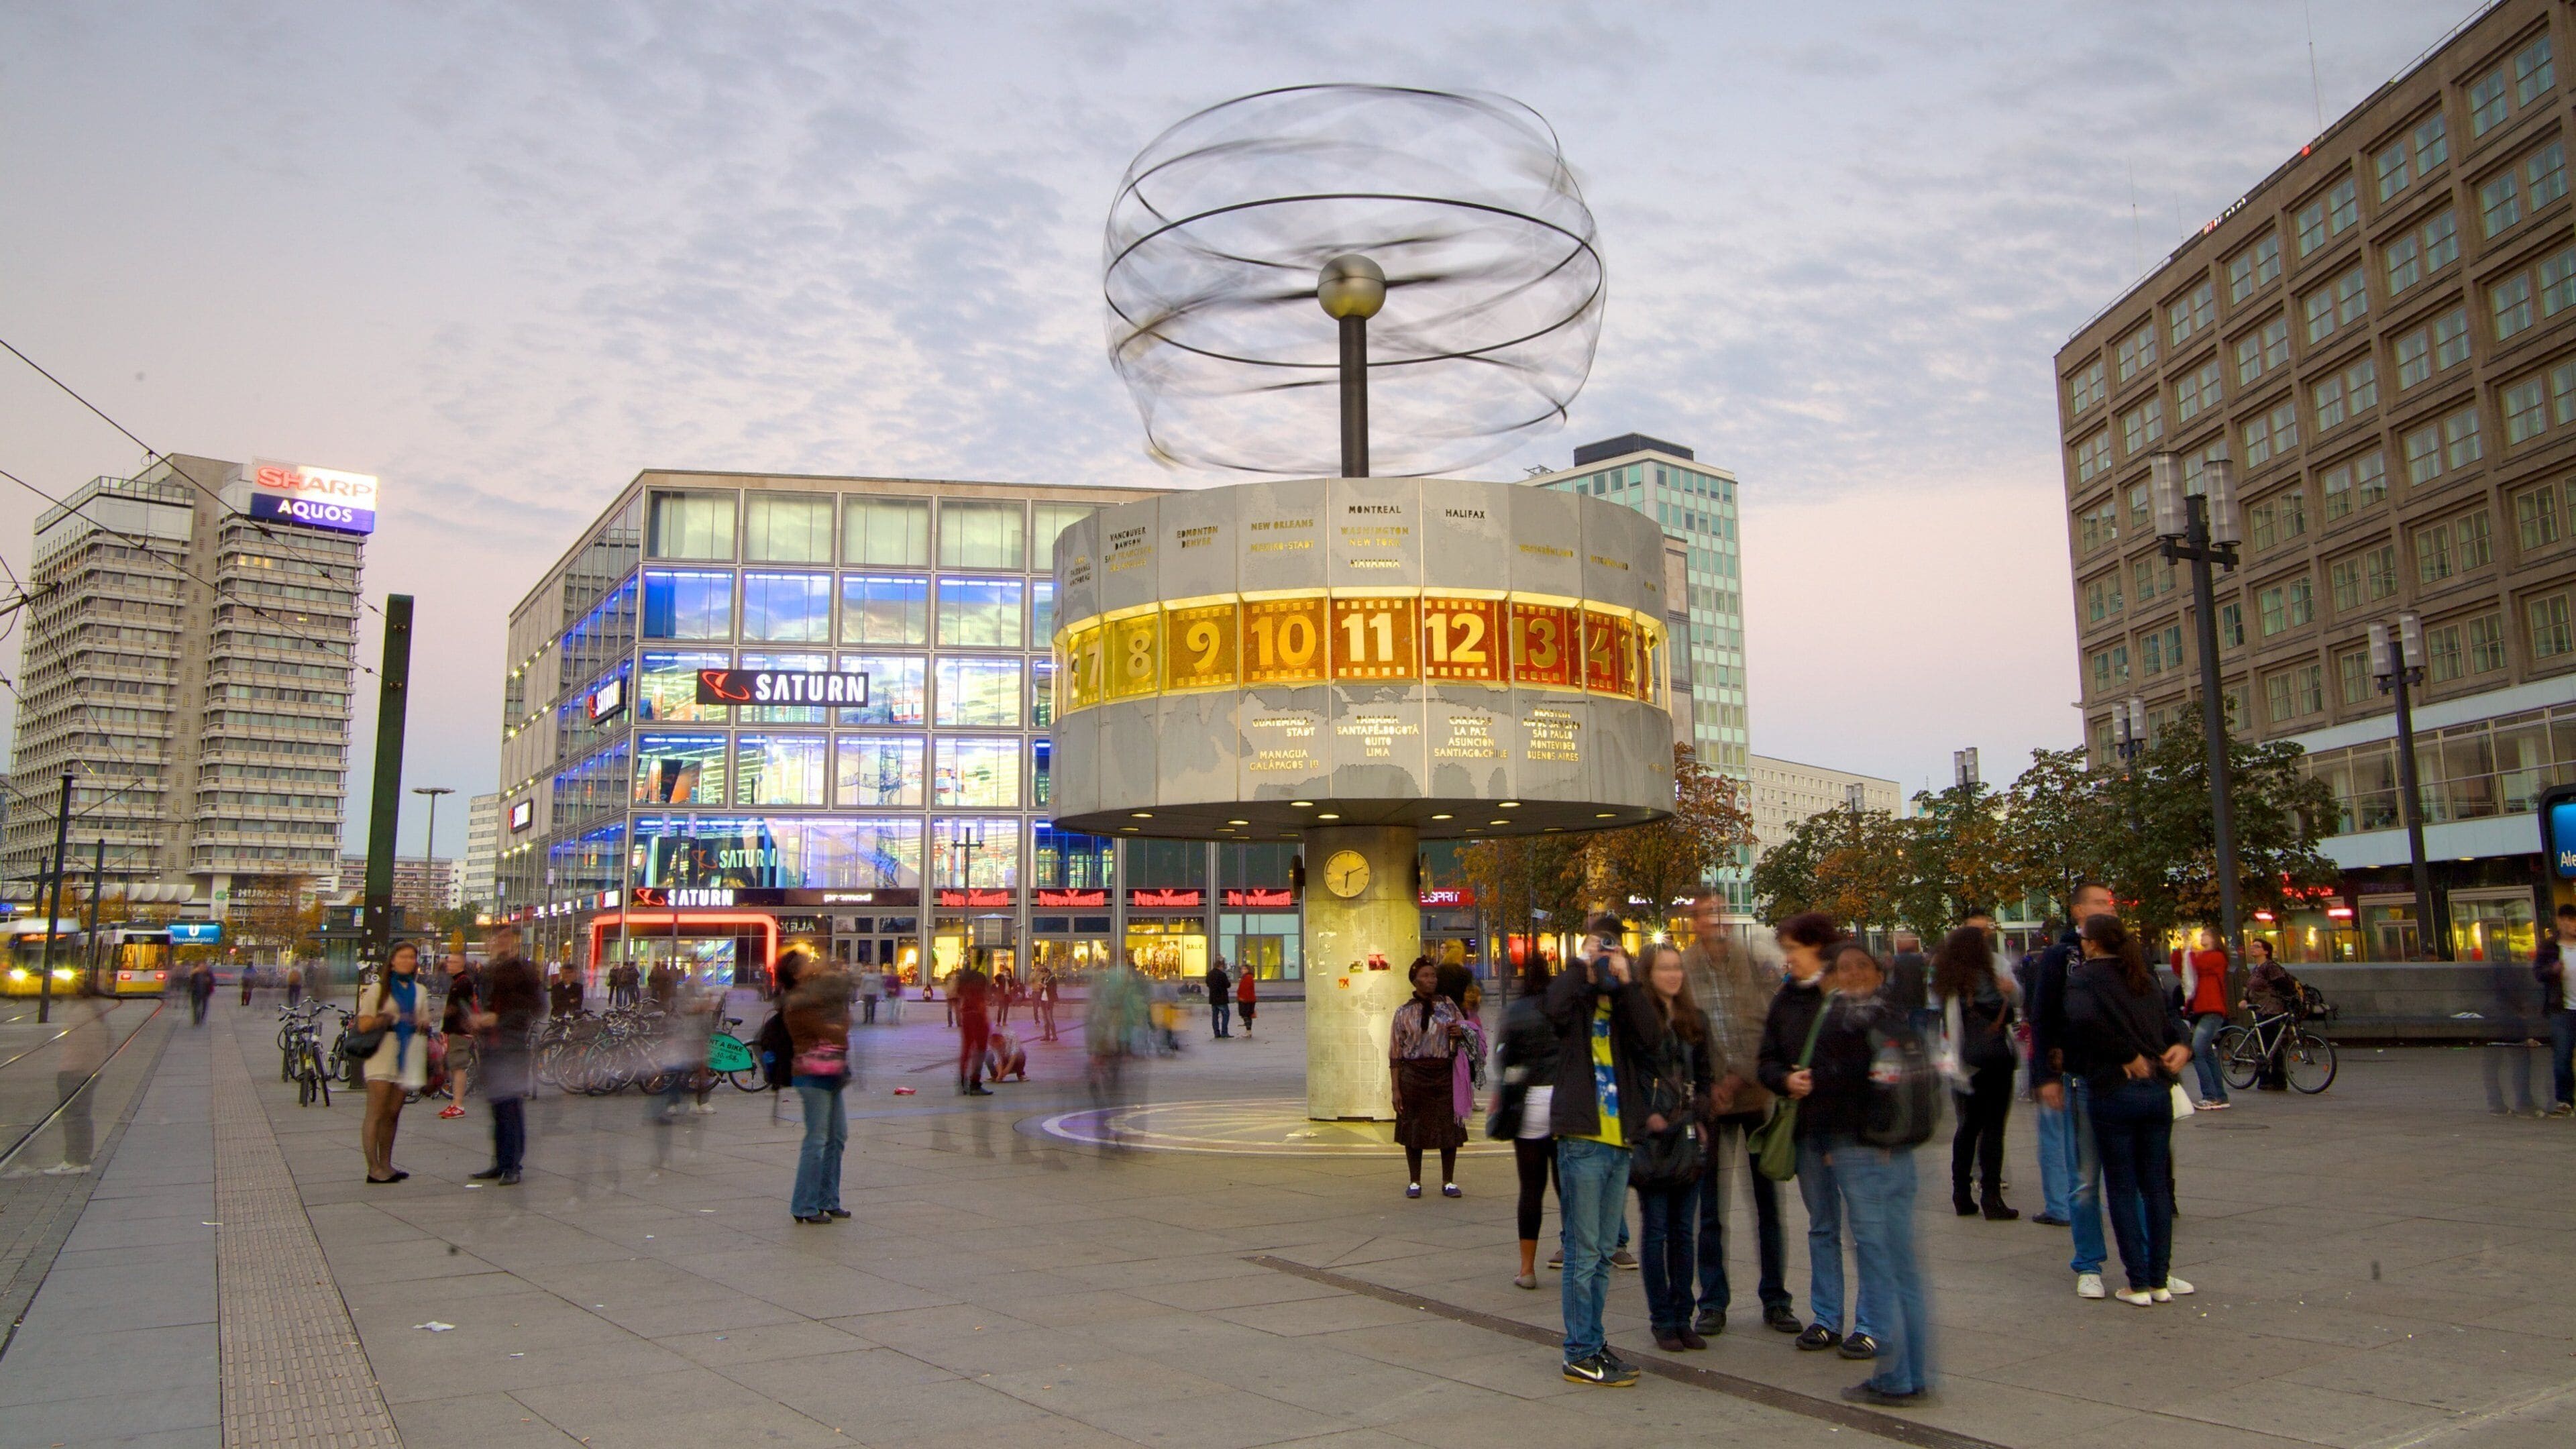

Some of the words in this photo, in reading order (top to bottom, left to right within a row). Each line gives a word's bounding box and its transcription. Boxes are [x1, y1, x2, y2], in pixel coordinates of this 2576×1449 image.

[258, 466, 372, 496] SHARP
[278, 500, 353, 523] AQUOS
[1348, 505, 1401, 514] MONTREAL
[1445, 508, 1485, 519] HALIFAX
[1250, 521, 1271, 531] NEW
[1274, 519, 1313, 529] ORLEANS
[1340, 527, 1409, 535] WASHINGTON
[1110, 526, 1146, 542] VANCOUVER
[1177, 525, 1218, 539] EDMONTON
[1114, 537, 1141, 551] DAWSON
[1181, 537, 1212, 548] DENVER
[1349, 538, 1371, 547] NEW
[1376, 538, 1401, 547] YORK
[1350, 559, 1401, 568] HAVANNA
[1251, 614, 1316, 665] 10
[1342, 612, 1393, 662] 11
[1426, 613, 1487, 663] 12
[1510, 617, 1558, 668] 13
[1186, 621, 1221, 669] 9
[1126, 631, 1152, 678] 8
[1086, 642, 1101, 688] 7
[755, 674, 865, 702] SATURN
[1449, 716, 1493, 726] CARACAS
[1286, 727, 1316, 737] STADT
[1454, 727, 1466, 736] LA
[1470, 727, 1488, 737] PAZ
[1532, 728, 1548, 738] SÃO
[1550, 729, 1573, 740] PAULO
[1364, 737, 1392, 746] QUITO
[1529, 739, 1576, 751] MONTEVIDEO
[1260, 749, 1309, 759] MANAGUA
[1366, 747, 1391, 757] LIMA
[1434, 747, 1480, 758] SANTIAGO
[1483, 749, 1508, 759] CHILE
[1527, 751, 1556, 760] BUENOS
[1558, 752, 1579, 761] AIRES
[1249, 758, 1303, 771] GALÁPAGOS
[719, 848, 776, 869] SATURN
[667, 889, 734, 906] SATURN
[823, 893, 872, 902] promod
[1421, 892, 1460, 903] ESPRIT
[188, 925, 200, 936] U
[727, 1042, 744, 1052] BIKE
